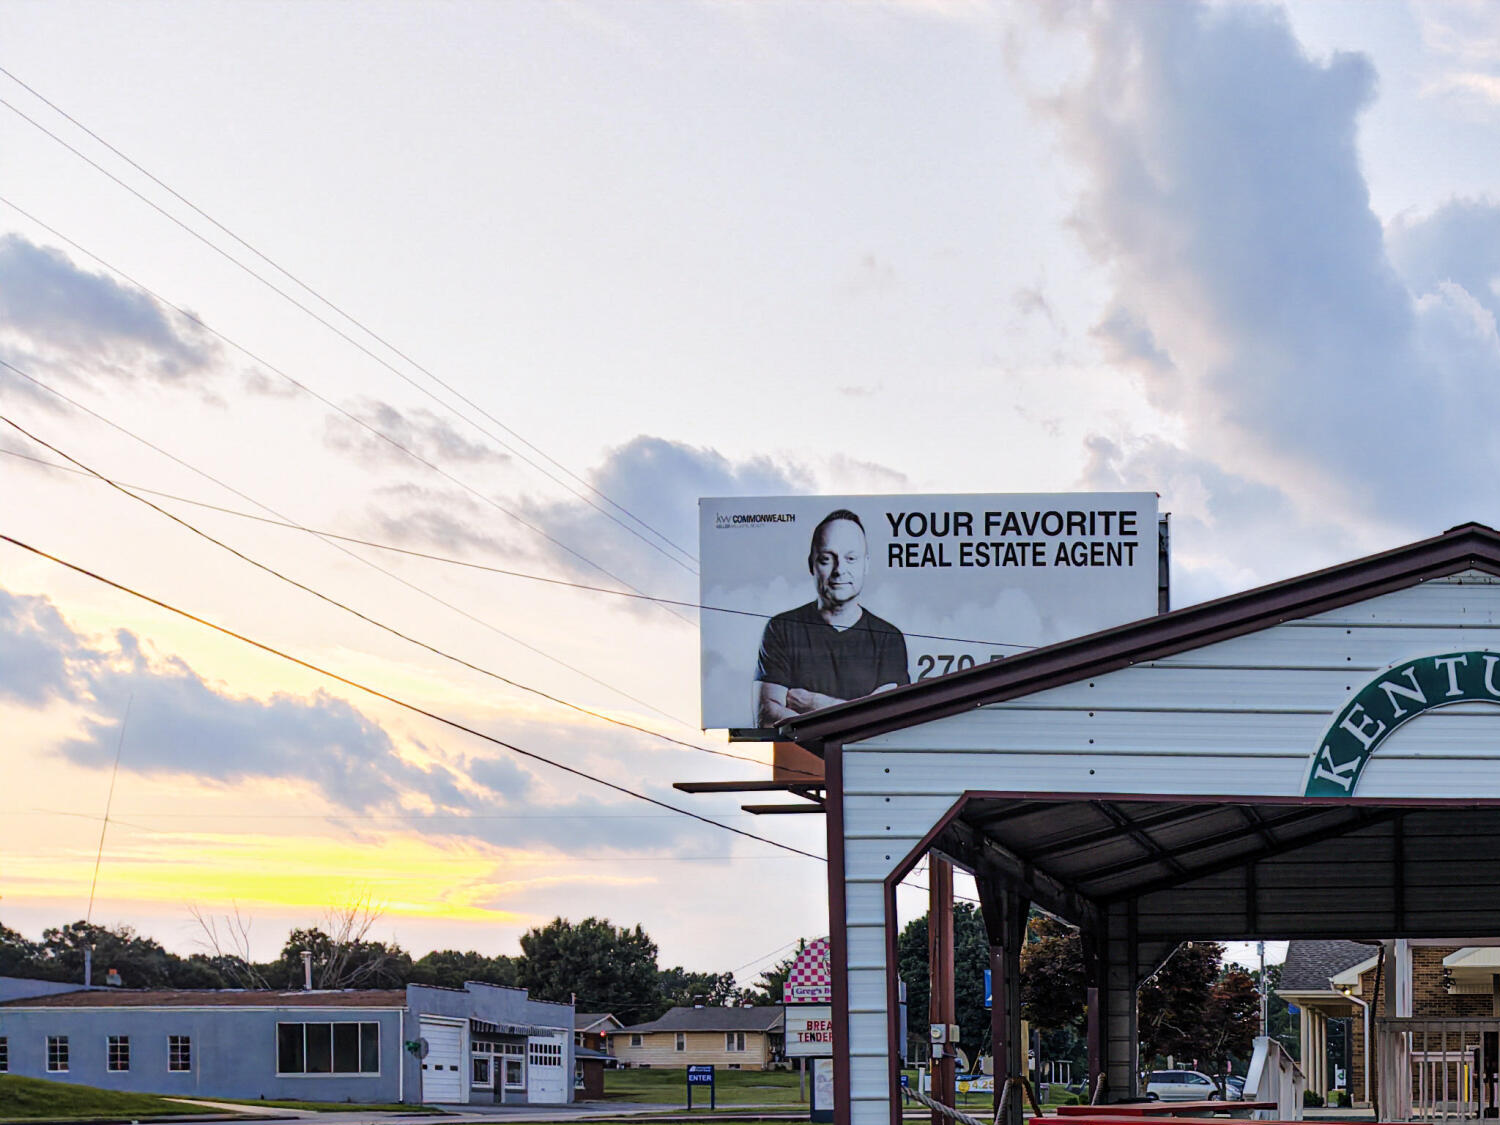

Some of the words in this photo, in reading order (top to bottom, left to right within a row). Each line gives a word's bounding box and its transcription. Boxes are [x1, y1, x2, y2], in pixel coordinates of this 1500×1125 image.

[732, 514, 796, 523] COMMONWEALTH
[886, 512, 973, 537] YOUR
[984, 510, 1138, 536] FAVORITE
[888, 543, 952, 567] REAL
[959, 542, 1047, 567] ESTATE
[1054, 541, 1138, 566] AGENT
[796, 988, 822, 996] Greg's
